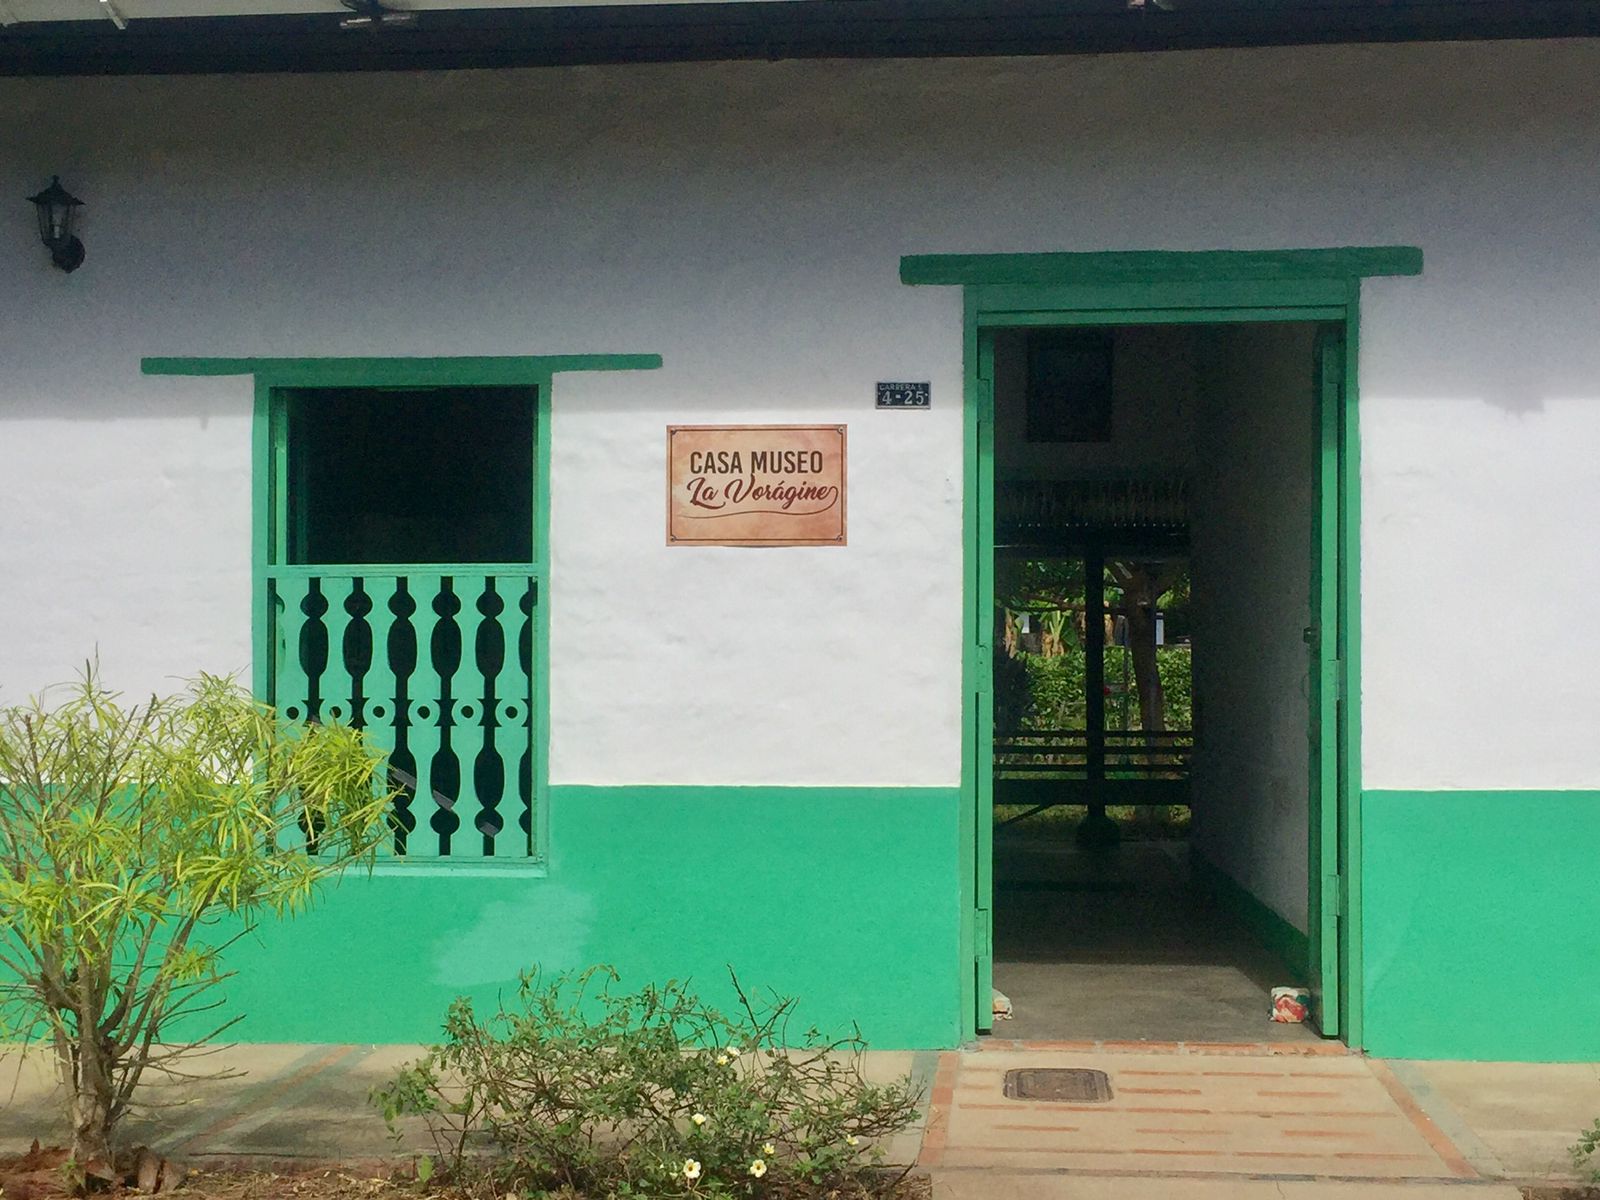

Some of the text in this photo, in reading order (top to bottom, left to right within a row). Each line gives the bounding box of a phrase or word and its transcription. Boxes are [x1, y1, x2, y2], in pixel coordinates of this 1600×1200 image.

[882, 390, 924, 405] 4-25
[689, 451, 823, 474] CASA MUSEO
[686, 473, 838, 510] La Vorágine
